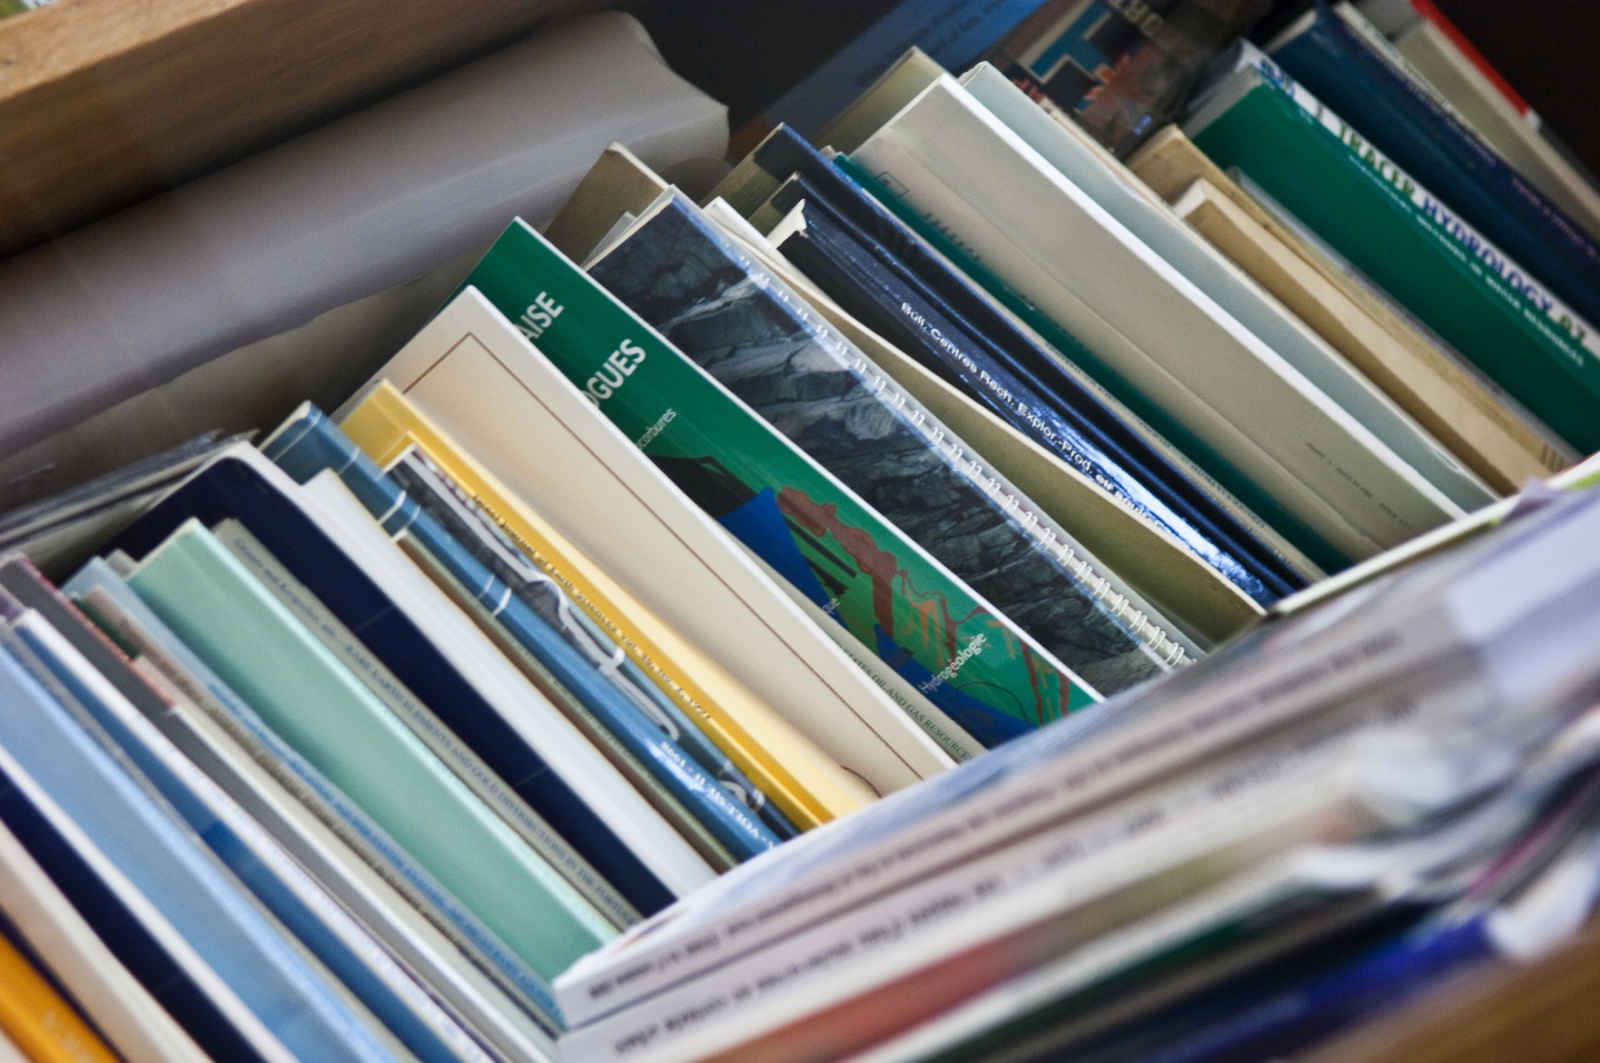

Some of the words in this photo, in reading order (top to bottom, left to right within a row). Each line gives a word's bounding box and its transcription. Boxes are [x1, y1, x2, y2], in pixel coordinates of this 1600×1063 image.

[1333, 124, 1421, 200] TRACER
[1417, 194, 1555, 315] HYDROLOGY
[897, 300, 931, 331] Bull.
[928, 326, 979, 374] Centres
[975, 369, 1019, 407] Rech.
[870, 672, 889, 691] OIL
[884, 685, 908, 707] AND
[903, 702, 926, 723] GAS
[469, 764, 500, 794] GOLD
[495, 789, 567, 859] DISTRIBUTIONS
[704, 782, 763, 839] VOLUME
